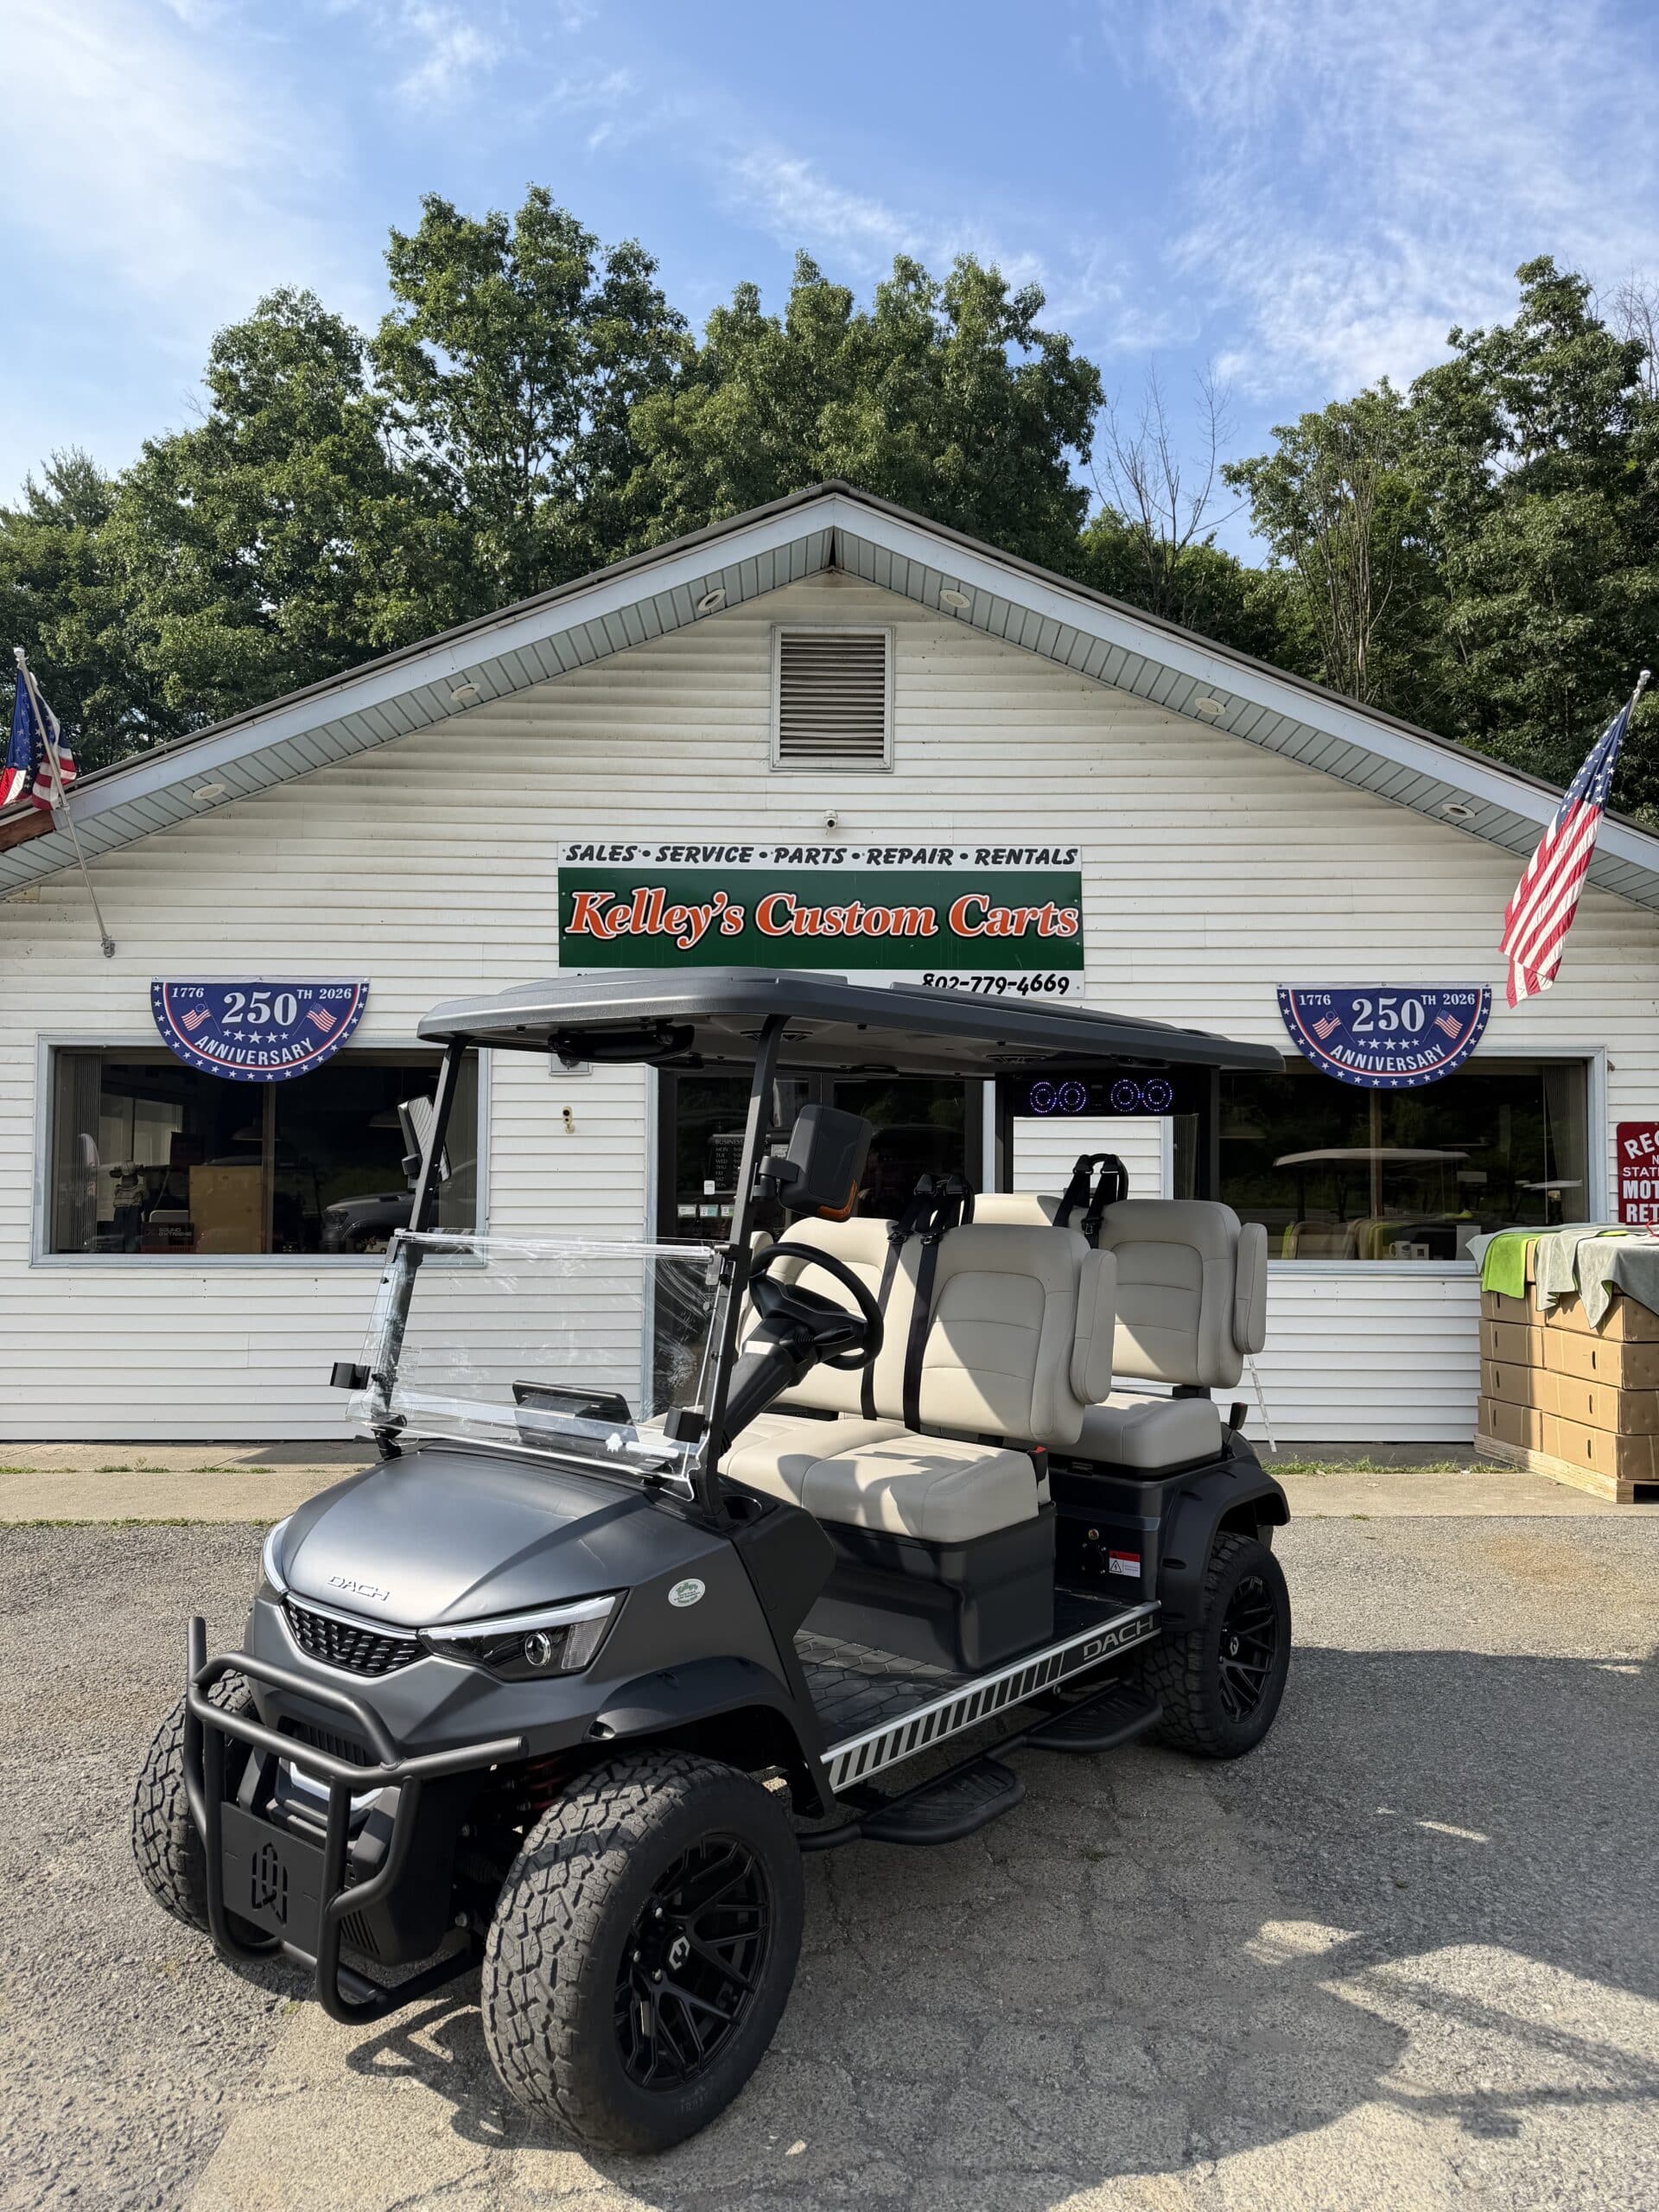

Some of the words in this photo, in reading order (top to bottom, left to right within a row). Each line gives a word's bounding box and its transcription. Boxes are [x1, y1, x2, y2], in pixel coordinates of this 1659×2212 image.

[566, 844, 638, 861] SALES
[655, 846, 754, 863] SERVICE
[773, 847, 848, 865] PARTS
[867, 848, 954, 866] REPAIR
[975, 848, 1078, 865] RENTALS
[564, 887, 745, 950] Kelley's
[755, 893, 938, 937] Custom
[949, 893, 1078, 938] Carts
[171, 987, 205, 998] 1776
[319, 988, 353, 1000] 2026
[922, 973, 1070, 995] 802-779-4669
[1299, 994, 1332, 1006] 1776
[1442, 993, 1476, 1005] 2026
[194, 1035, 315, 1065] ANNIVERSARY
[1330, 1043, 1446, 1071] ANNIVERSARY
[1623, 1166, 1659, 1177] STAT
[327, 1576, 390, 1601] DACH
[1084, 1614, 1154, 1661] DACH
